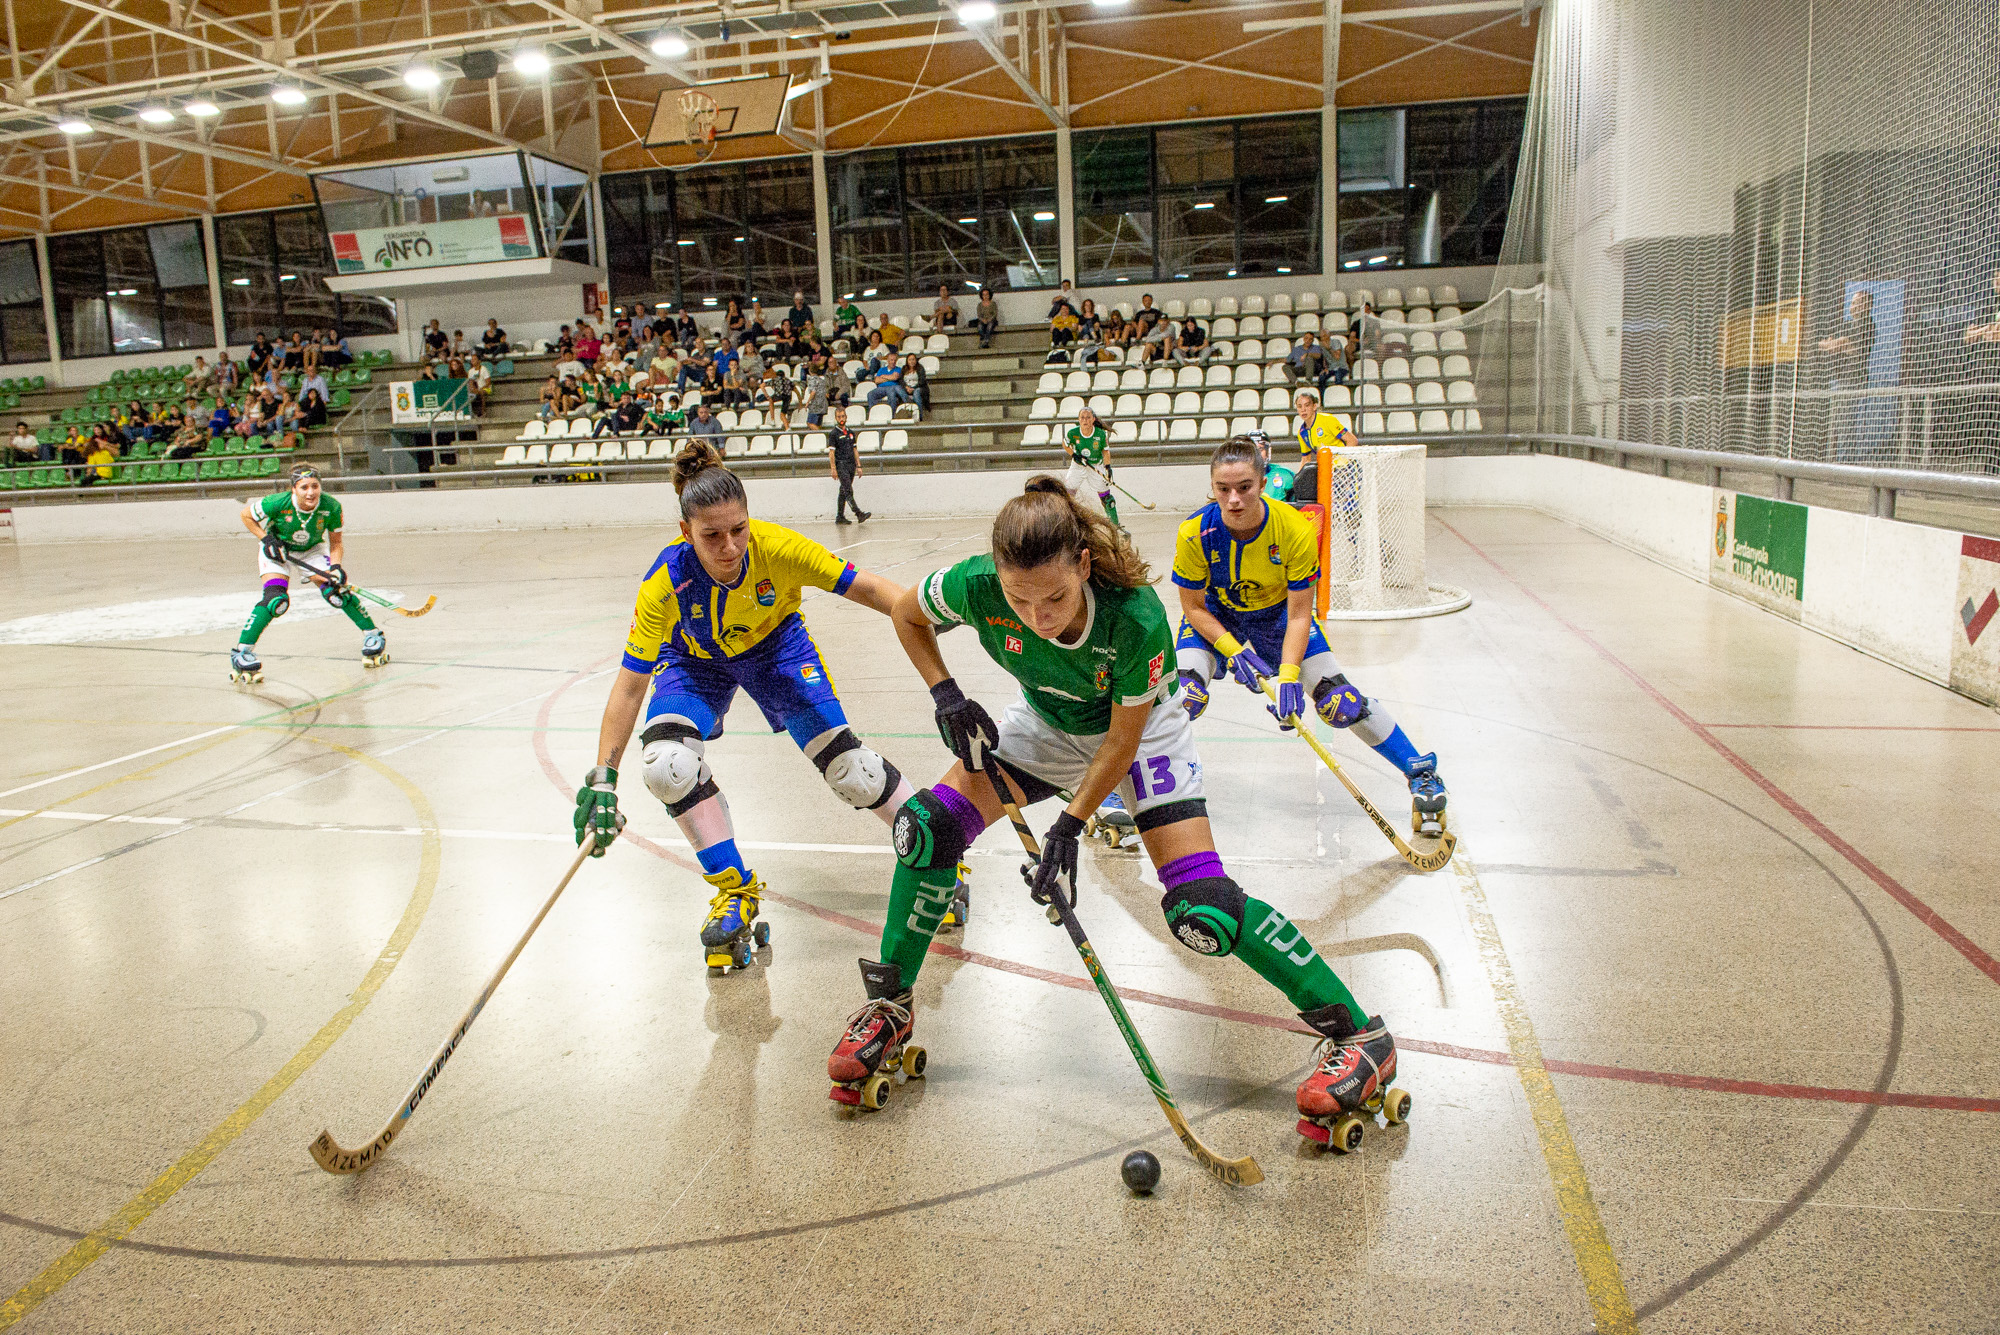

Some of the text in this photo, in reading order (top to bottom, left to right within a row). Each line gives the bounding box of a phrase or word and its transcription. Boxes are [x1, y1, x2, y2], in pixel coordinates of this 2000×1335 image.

[385, 238, 433, 261] INFO
[985, 616, 1023, 634] VACEX
[1128, 754, 1177, 801] 13
[1357, 795, 1396, 845] SUPER
[1405, 849, 1447, 869] AZEMAD
[861, 1040, 884, 1060] GEMMA
[408, 1021, 468, 1114] COMPACT
[1335, 1076, 1361, 1097] GEMMA
[329, 1129, 393, 1171] AZEMAD
